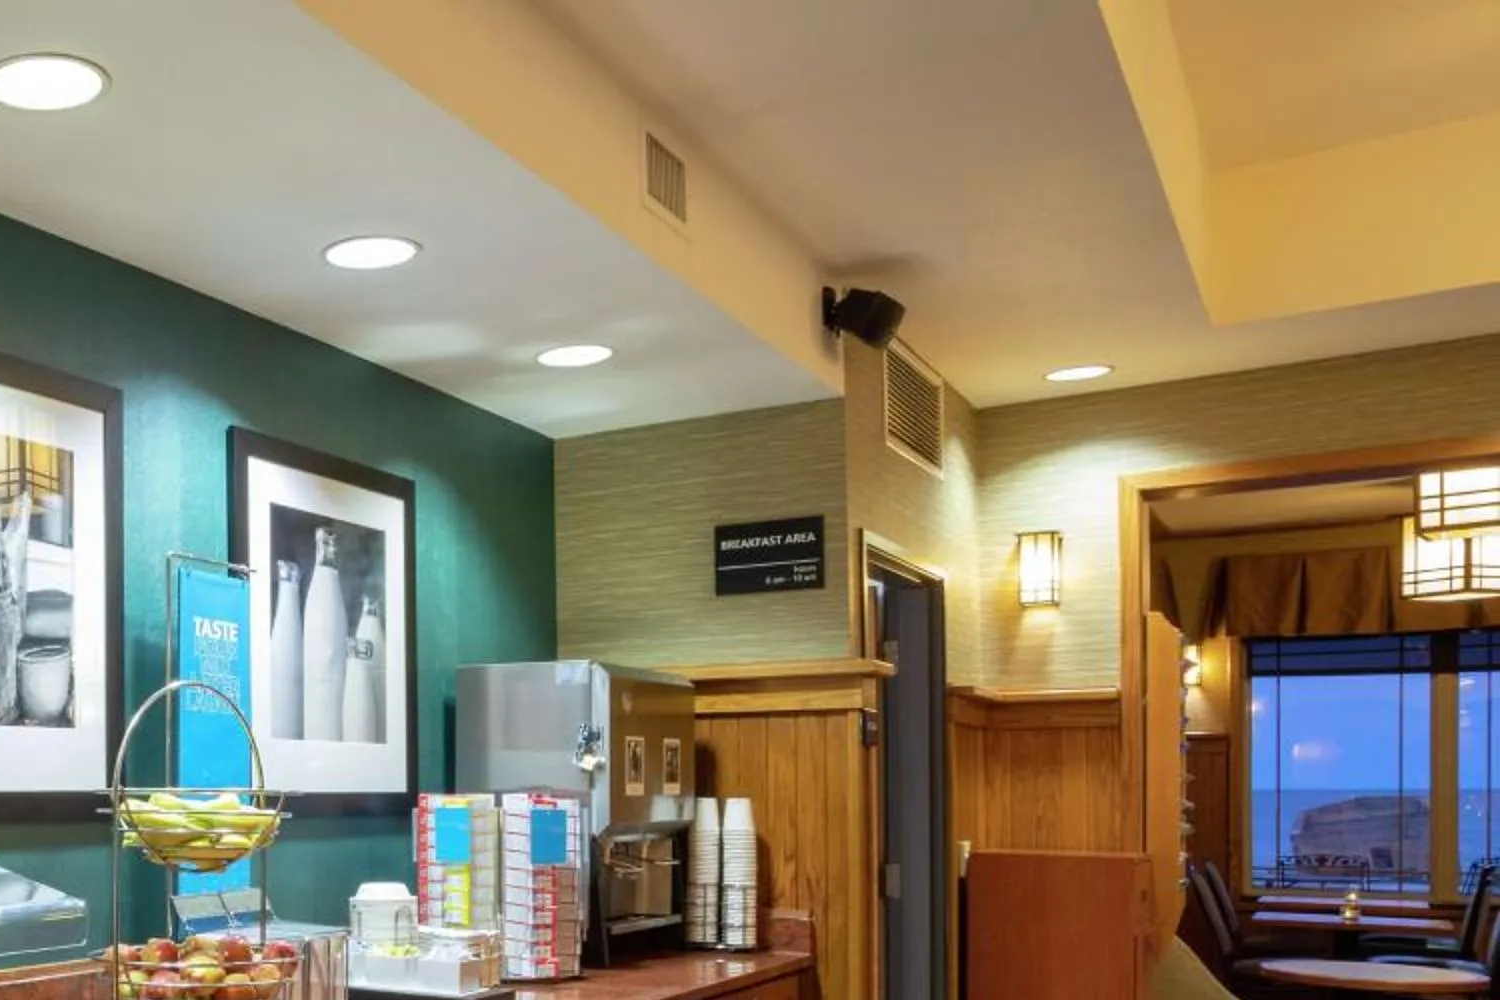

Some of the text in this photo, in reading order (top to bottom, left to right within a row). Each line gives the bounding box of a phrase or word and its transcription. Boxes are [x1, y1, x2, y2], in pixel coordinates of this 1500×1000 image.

[720, 532, 817, 551] BREAKFAST AREA
[192, 616, 239, 643] TASTE
